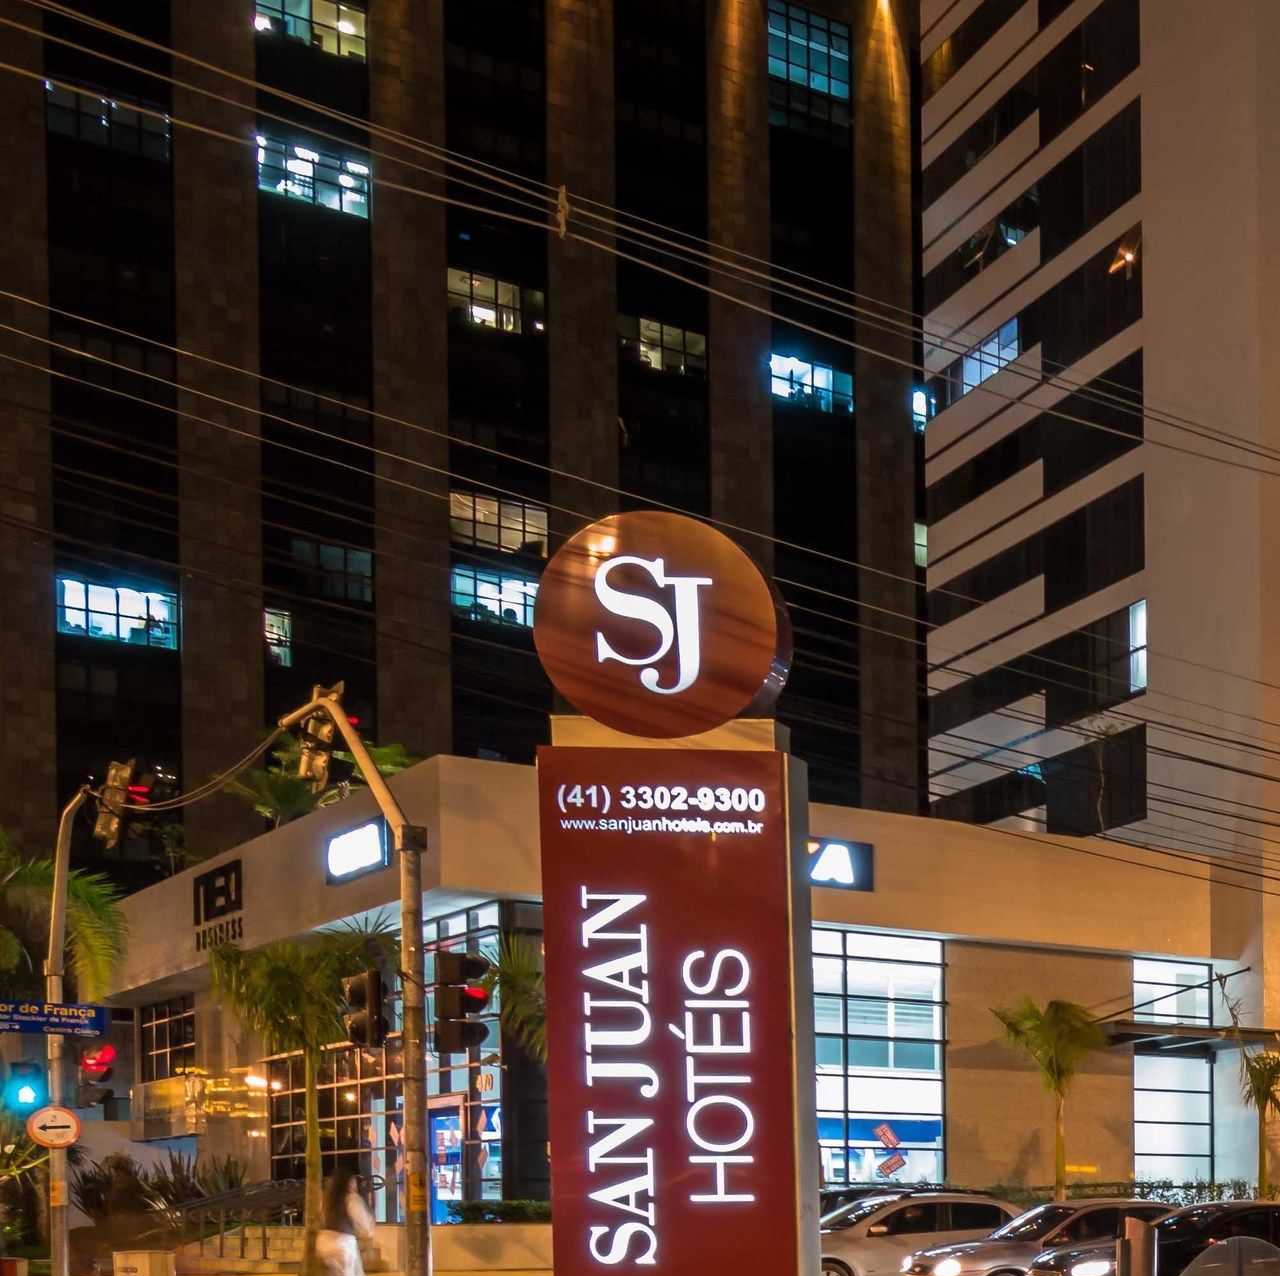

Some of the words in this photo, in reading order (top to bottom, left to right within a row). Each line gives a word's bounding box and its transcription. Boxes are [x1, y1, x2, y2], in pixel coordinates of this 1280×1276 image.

[594, 555, 713, 695] SJ
[557, 784, 612, 814] (41)
[620, 785, 766, 812] 3302-9300
[20, 1003, 39, 1014] de
[44, 1004, 96, 1019] França
[581, 885, 660, 1098] JUAN
[668, 948, 755, 1202] HOTÉIS
[588, 1110, 658, 1265] SAN
